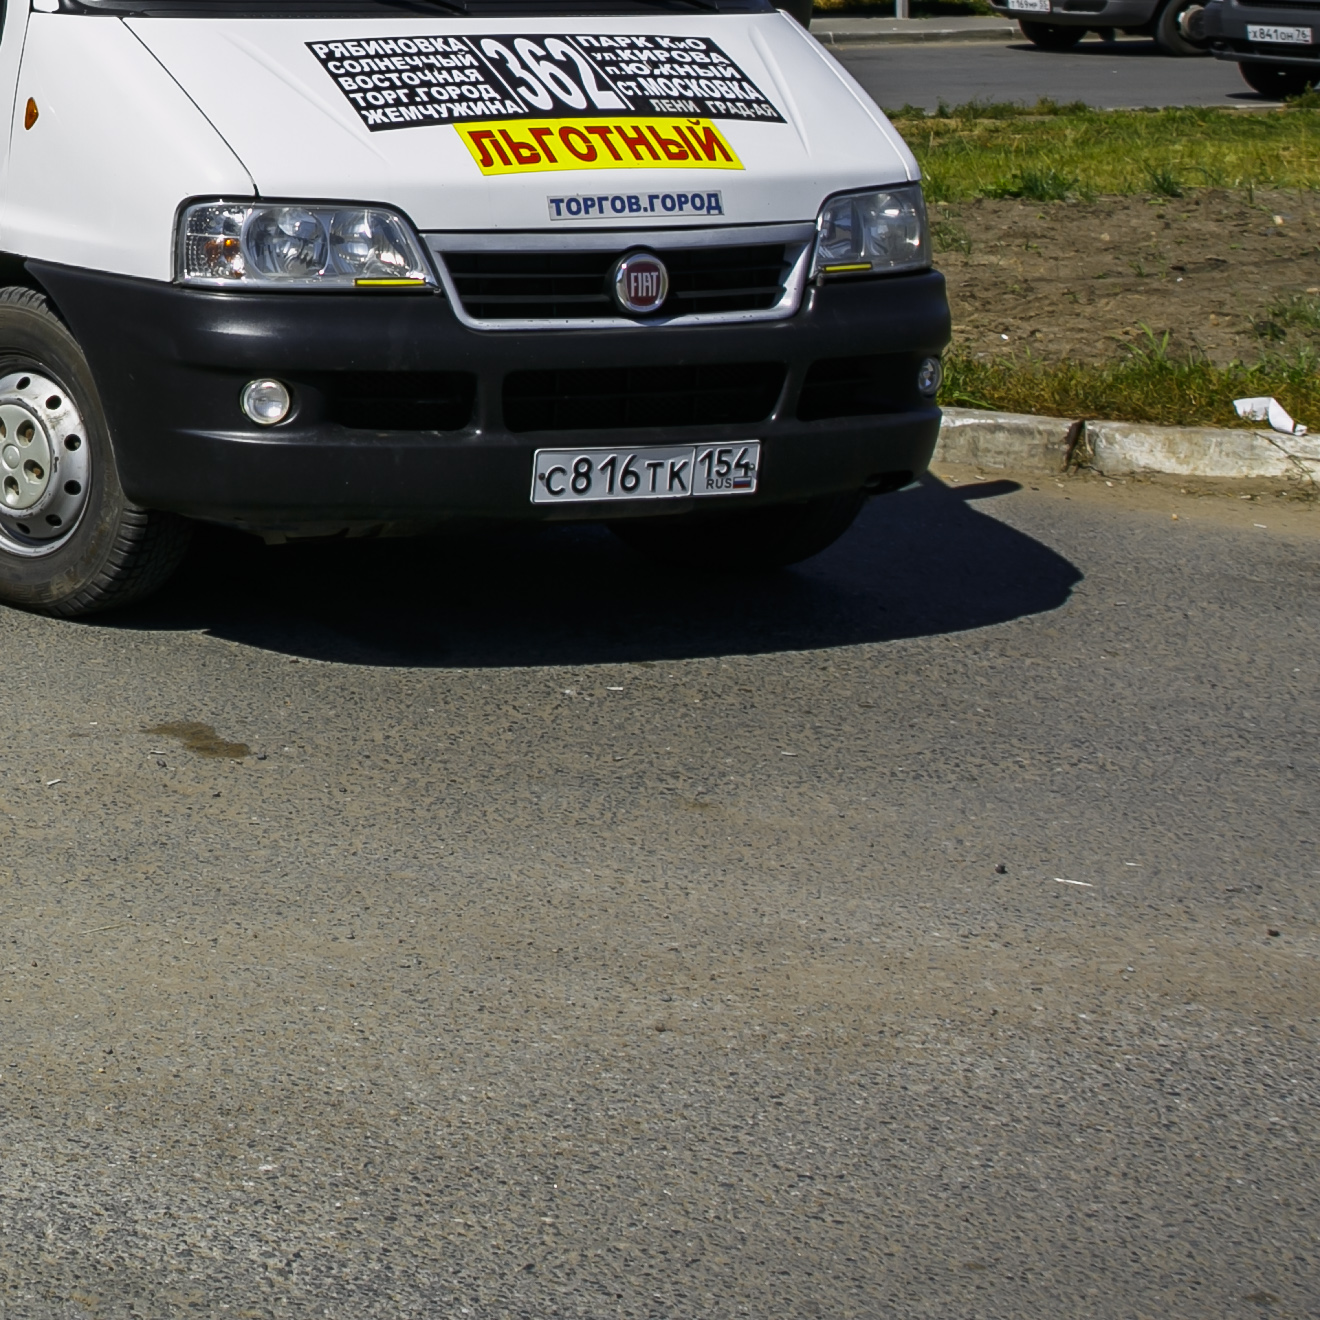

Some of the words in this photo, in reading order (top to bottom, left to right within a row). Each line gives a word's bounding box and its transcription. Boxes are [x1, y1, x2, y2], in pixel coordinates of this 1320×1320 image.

[311, 37, 470, 59] РЯБИНОВКА
[575, 35, 655, 48] ПАРК
[591, 49, 731, 65] ул.КИРОВА
[337, 68, 485, 91] ВОСТОЧНАЯ
[479, 38, 627, 110] 362
[348, 84, 502, 107] ТОРГ.ГОРОД
[616, 76, 765, 101] ст.МОСКОВКА
[361, 100, 524, 125] ЖЕМЧУЖИНА
[467, 118, 734, 168] ЛЬГОТНЫЙ
[550, 192, 722, 217] ТОРГОВ.ГОРОД
[630, 271, 659, 298] FIAT
[545, 453, 689, 496] С816ТК
[697, 446, 751, 479] 154
[705, 477, 733, 490] RUS
